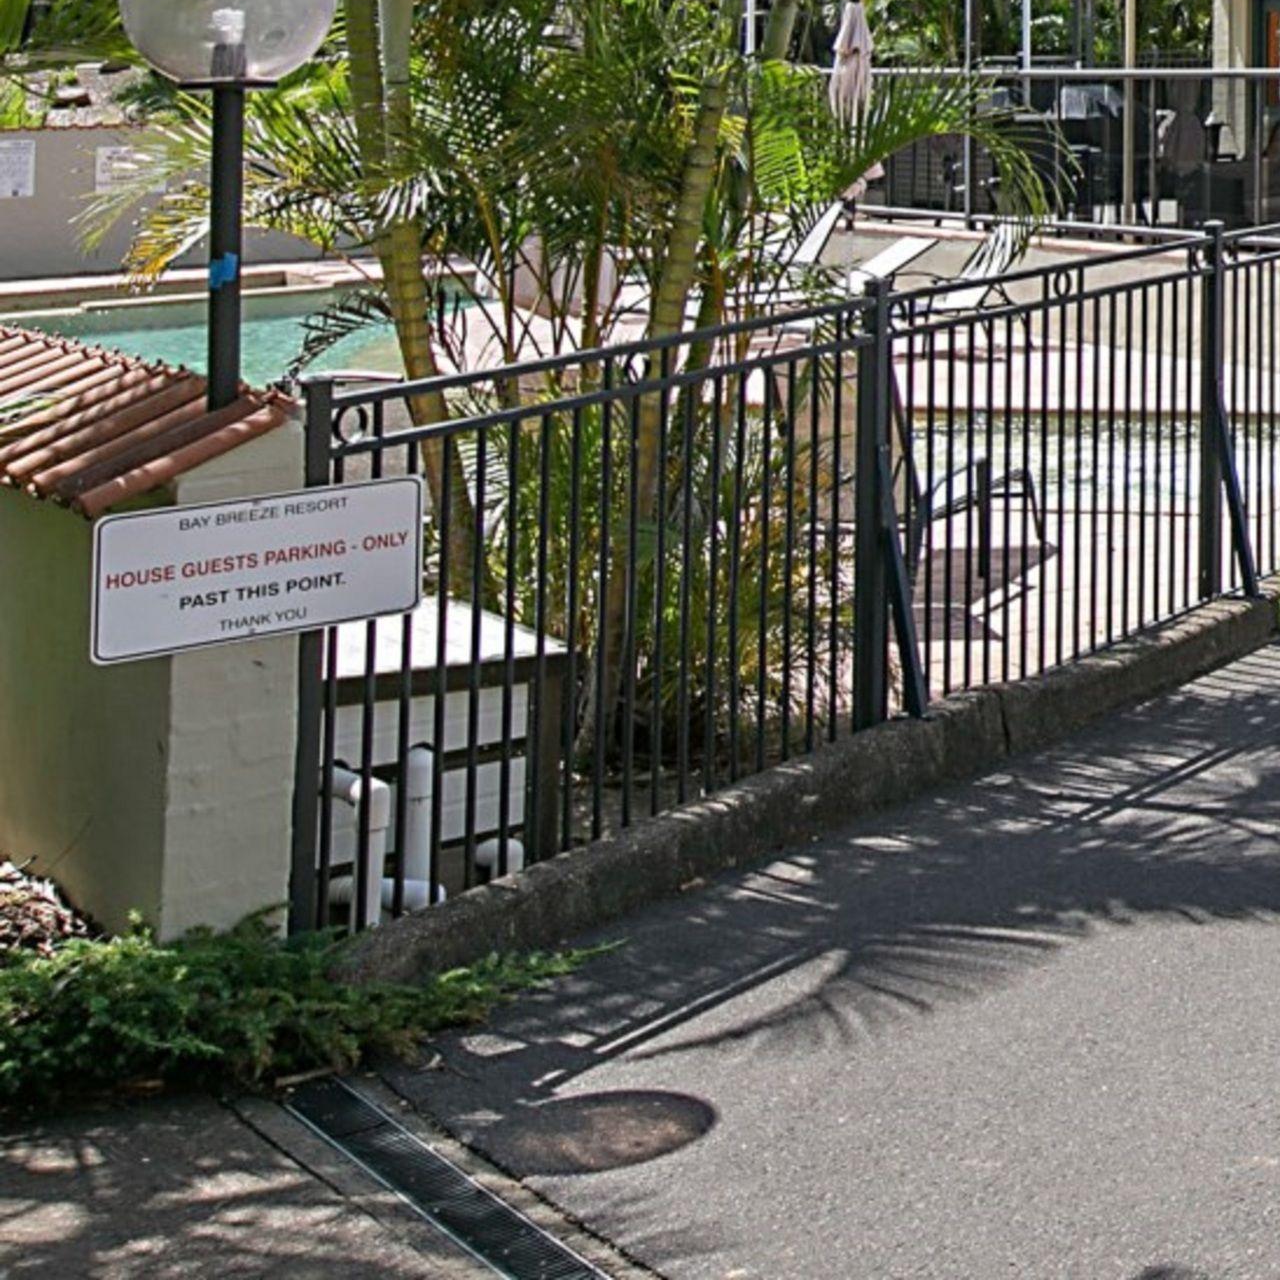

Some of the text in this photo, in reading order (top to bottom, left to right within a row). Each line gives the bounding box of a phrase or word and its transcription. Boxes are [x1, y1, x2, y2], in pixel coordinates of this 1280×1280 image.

[178, 496, 348, 531] BAY BREEZE RESORT
[105, 564, 175, 590] HOUSE
[181, 553, 258, 579] GUESTS
[263, 540, 347, 565] PARKING
[362, 531, 409, 553] ONLY
[178, 571, 347, 610] PAST THIS POINT.
[219, 606, 307, 632] THANK YOU
